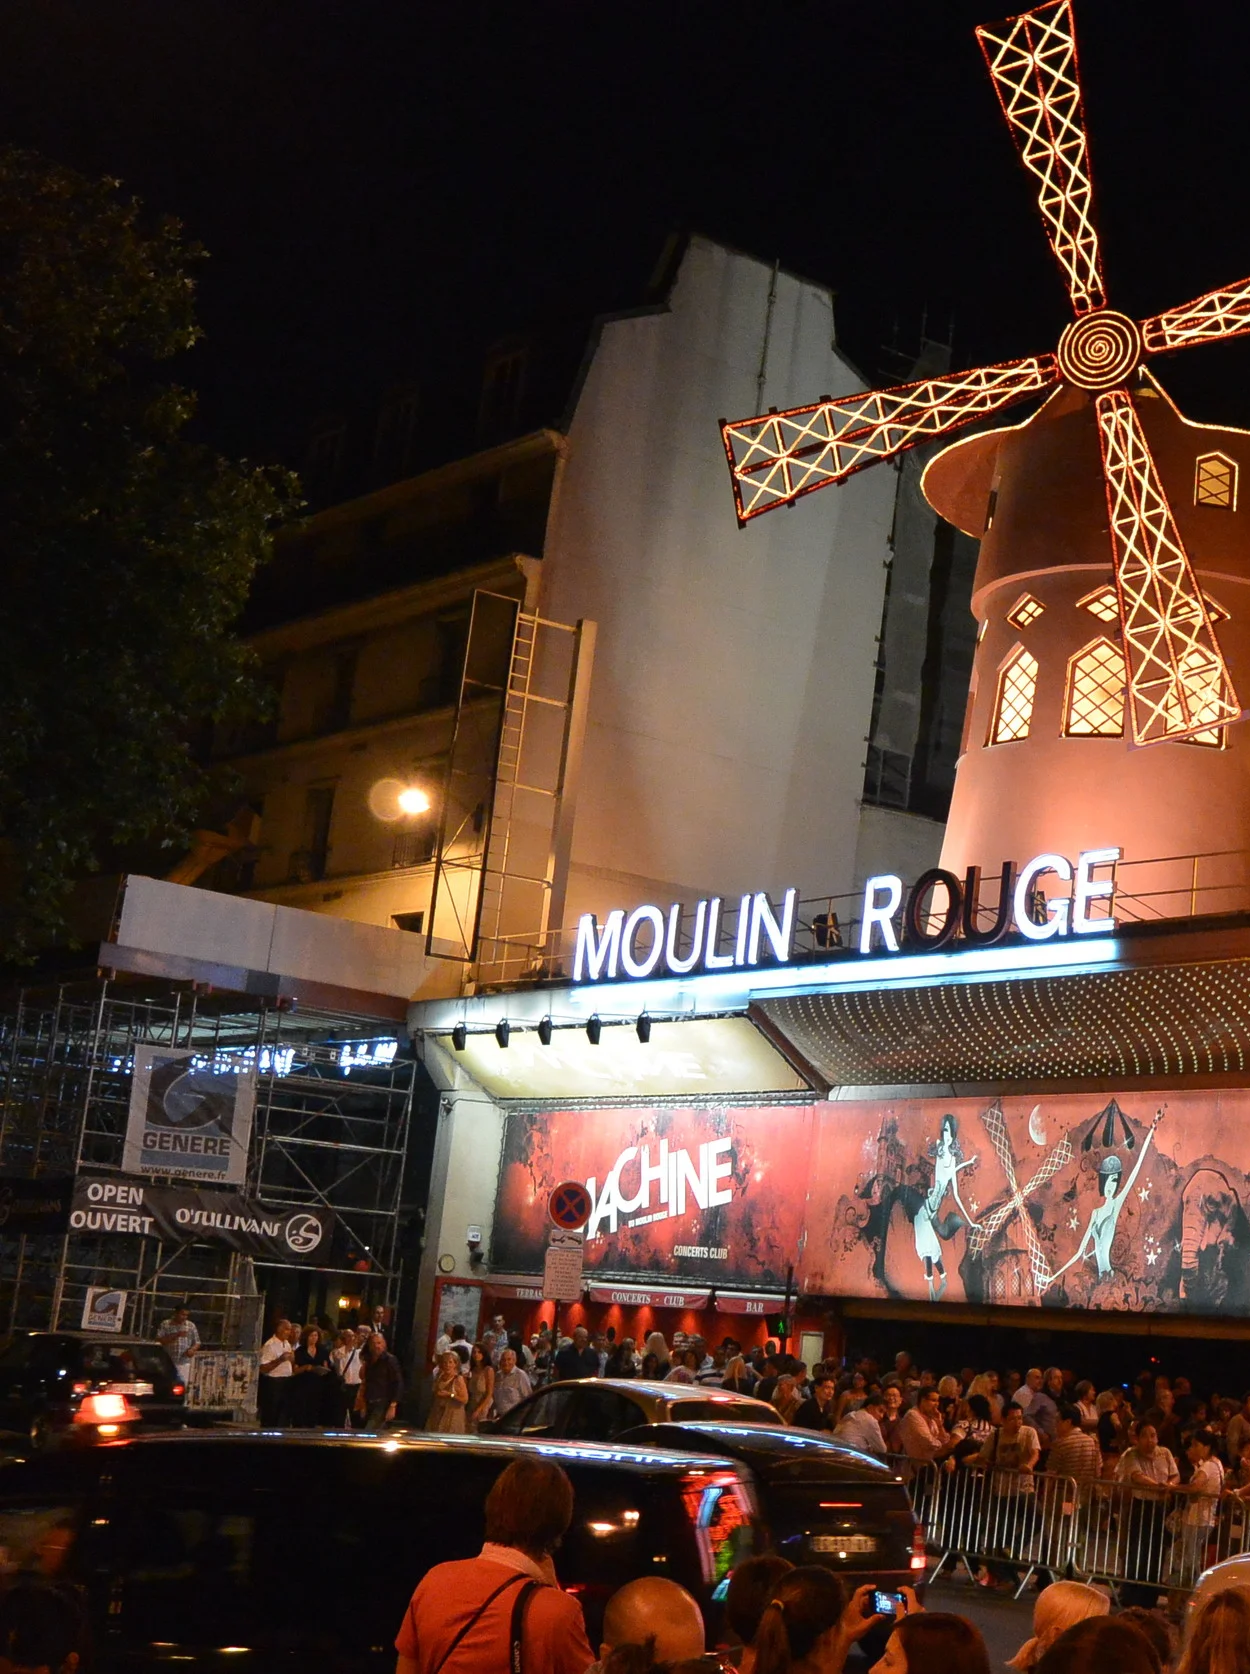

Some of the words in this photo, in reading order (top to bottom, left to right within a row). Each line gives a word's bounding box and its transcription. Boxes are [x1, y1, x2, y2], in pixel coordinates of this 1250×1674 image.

[572, 885, 798, 982] MOULIN
[859, 846, 1125, 955] ROUGE
[142, 1131, 231, 1156] GENERE
[140, 1164, 227, 1180] www.genere.fr
[87, 1182, 144, 1206] OPEN
[70, 1210, 154, 1235] OUVERT
[175, 1207, 282, 1237] O'SULLIVANS
[673, 1244, 709, 1259] CONCERTS
[709, 1247, 728, 1259] CLUB
[611, 1291, 651, 1304] CONCERTS
[664, 1295, 685, 1307] CLUB
[746, 1301, 764, 1313] BAR
